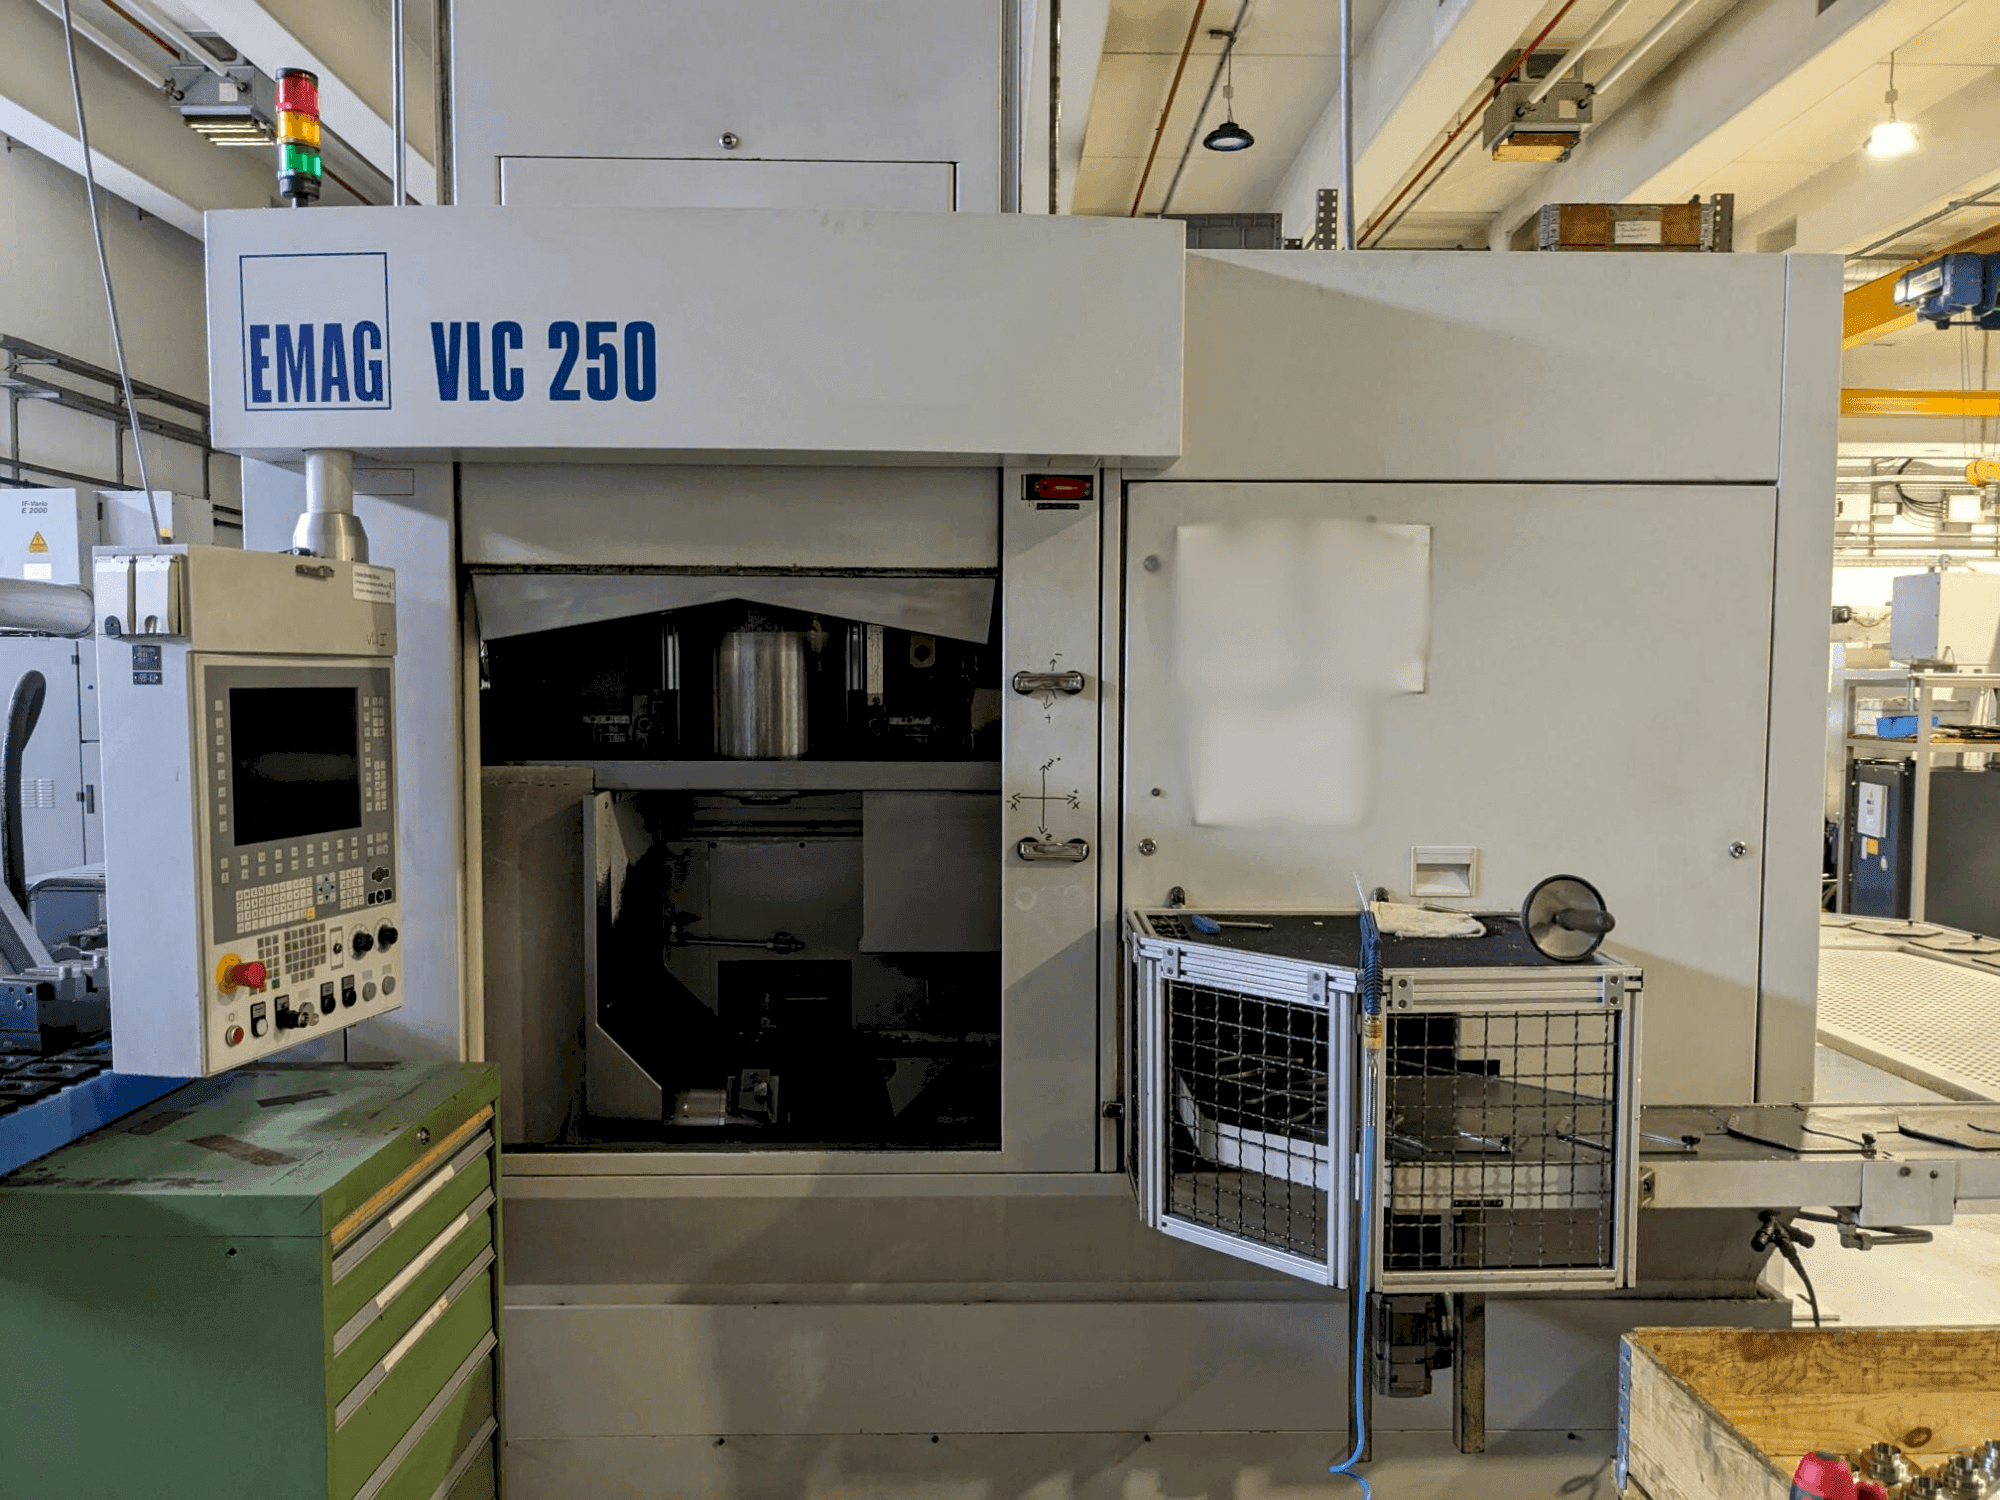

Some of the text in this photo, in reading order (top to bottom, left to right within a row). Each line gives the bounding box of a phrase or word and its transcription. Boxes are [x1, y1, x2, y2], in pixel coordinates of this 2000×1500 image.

[250, 320, 657, 403] EMAG VLC 250
